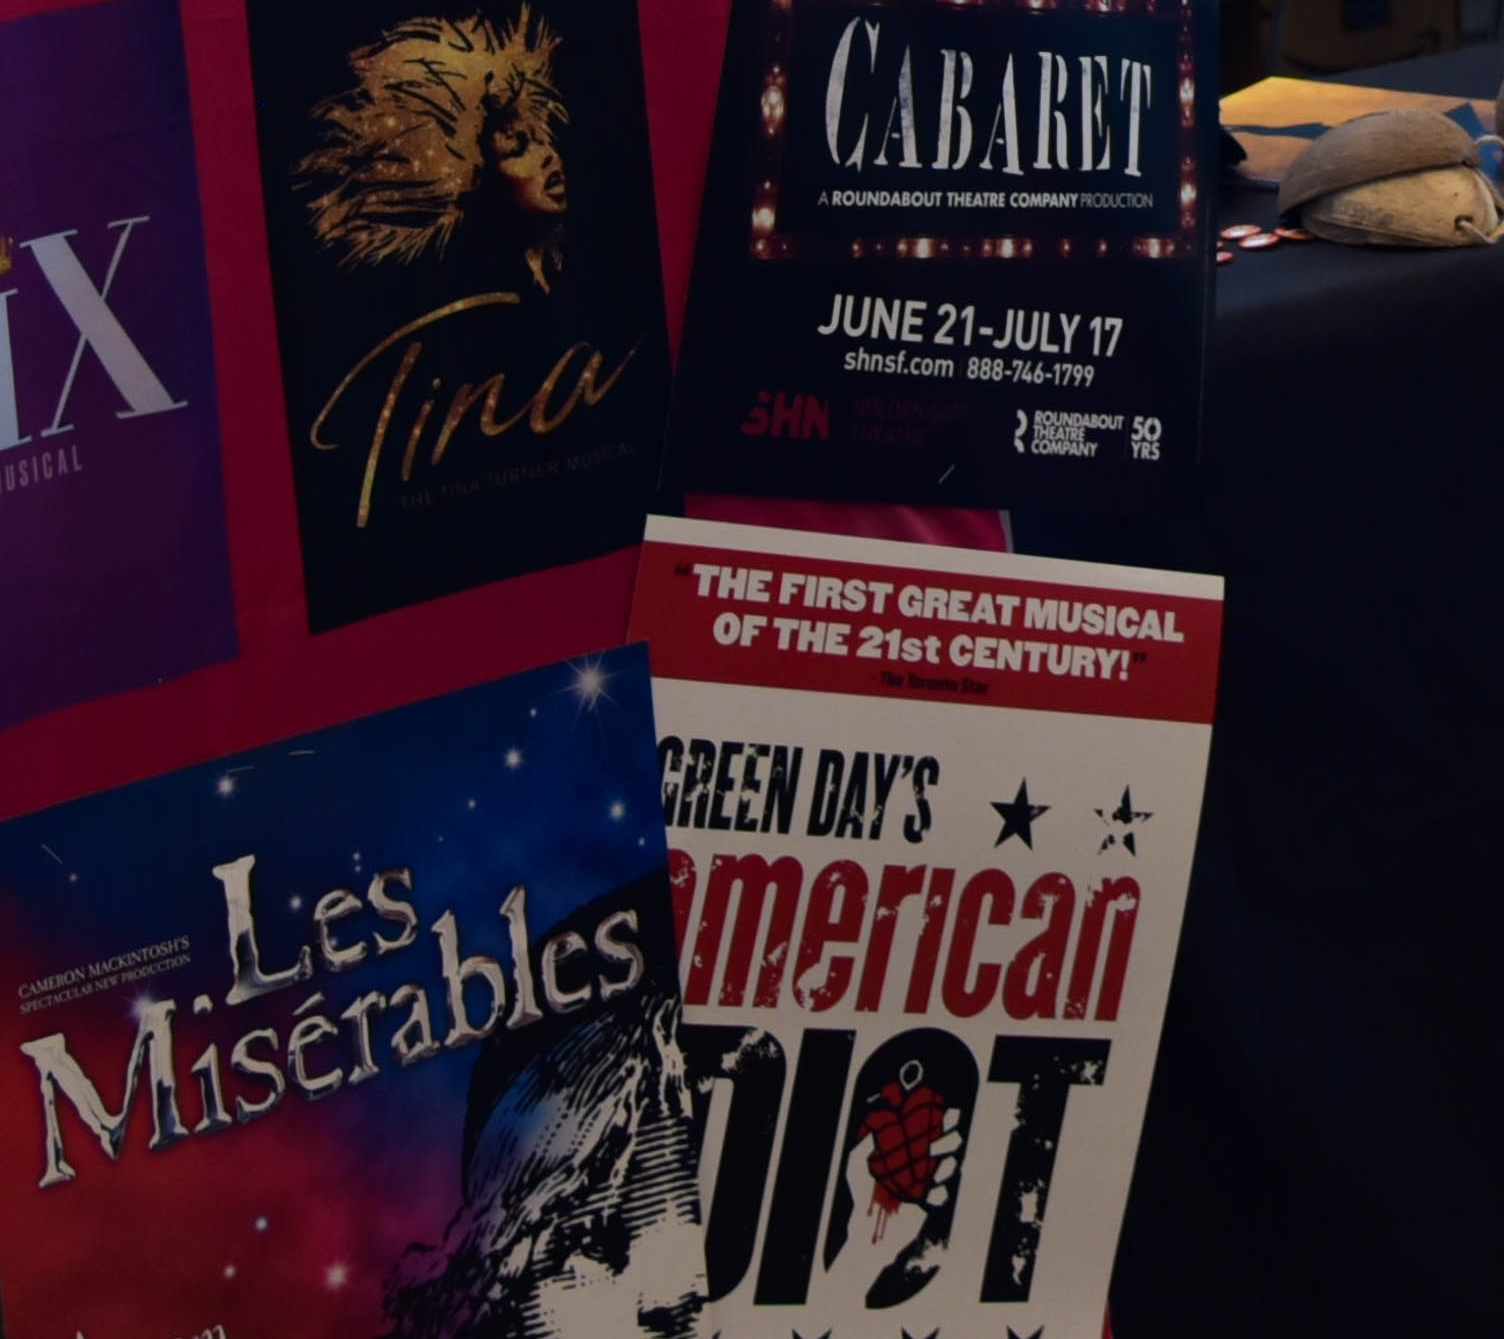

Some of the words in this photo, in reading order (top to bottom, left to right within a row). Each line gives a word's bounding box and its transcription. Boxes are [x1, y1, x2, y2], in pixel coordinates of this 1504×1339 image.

[824, 16, 1152, 177] CABARET
[818, 192, 829, 206] A
[832, 191, 943, 207] ROUNDABOUT
[947, 193, 1006, 207] THEATRE
[1010, 193, 1080, 208] COMPANY
[1080, 193, 1154, 208] PRODUCTION
[817, 294, 927, 343] JUNE
[1089, 317, 1124, 357] 17
[844, 347, 954, 379] shnsf.com
[967, 357, 1095, 387] 888-746-1799
[310, 290, 644, 528] Tina
[1131, 418, 1162, 441] 50
[1130, 443, 1161, 461] YRS
[712, 612, 766, 647] OF
[774, 618, 850, 656] THE
[856, 628, 942, 665] 21st
[778, 573, 893, 616] FIRST
[897, 580, 1020, 626] GREAT
[1025, 600, 1184, 643] MUSICAL
[658, 733, 804, 834] GREEN
[806, 746, 940, 844] DAY'S
[212, 854, 418, 1007] Les
[20, 884, 645, 1189] Misérables
